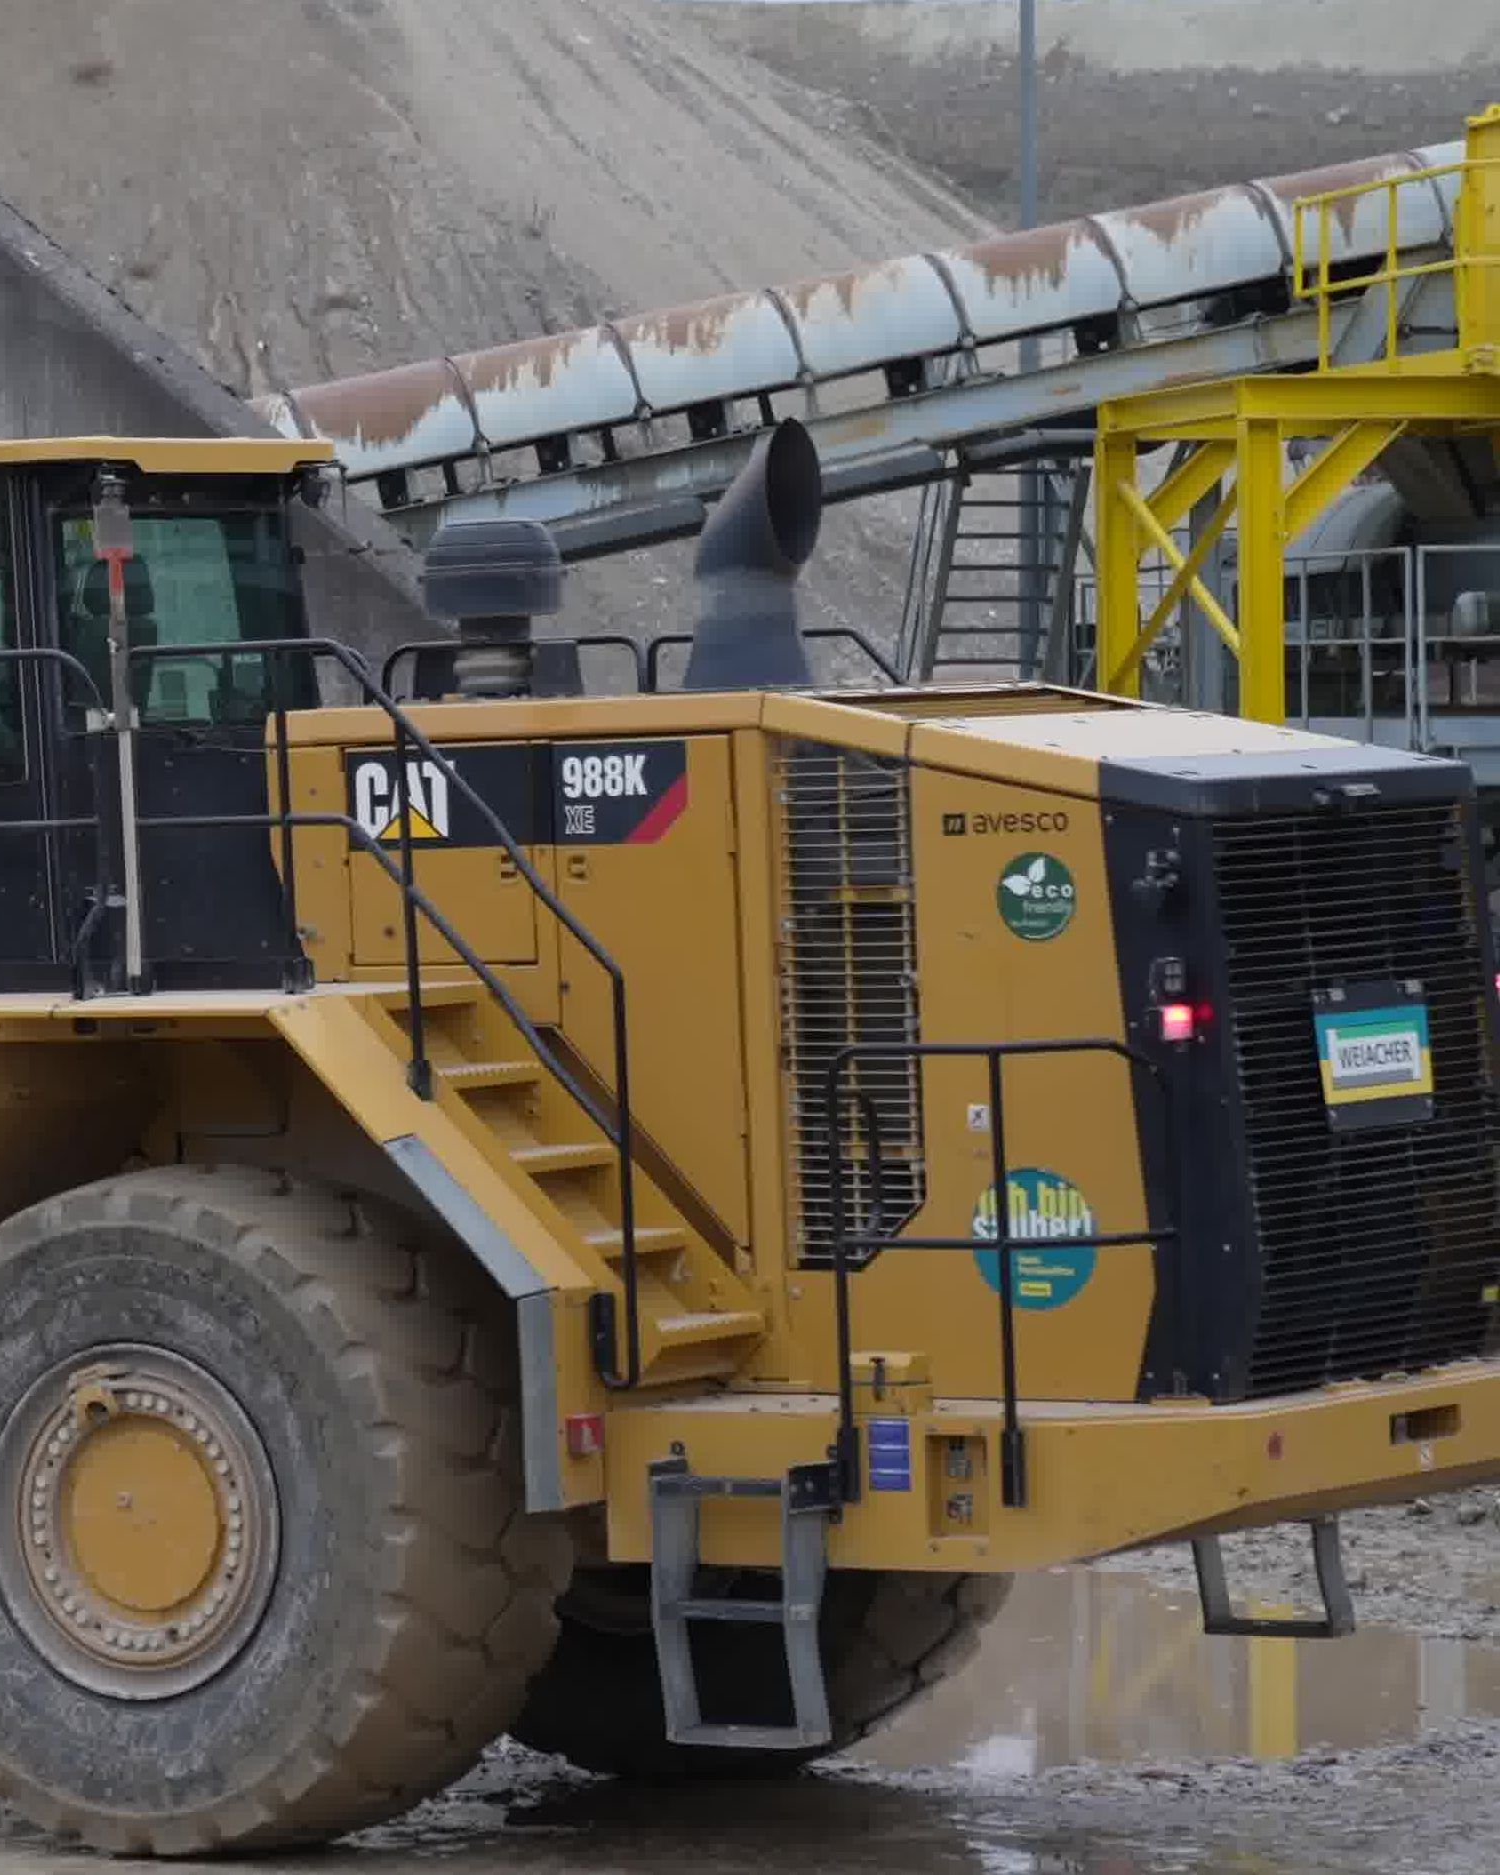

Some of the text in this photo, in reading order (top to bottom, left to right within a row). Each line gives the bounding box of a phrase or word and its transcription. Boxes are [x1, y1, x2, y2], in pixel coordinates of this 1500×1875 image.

[562, 754, 647, 799] 988K
[356, 760, 454, 840] CAT
[564, 804, 596, 835] XE
[972, 811, 1069, 834] avesco
[1031, 883, 1073, 899] eco
[1339, 1040, 1413, 1069] WEIACHER
